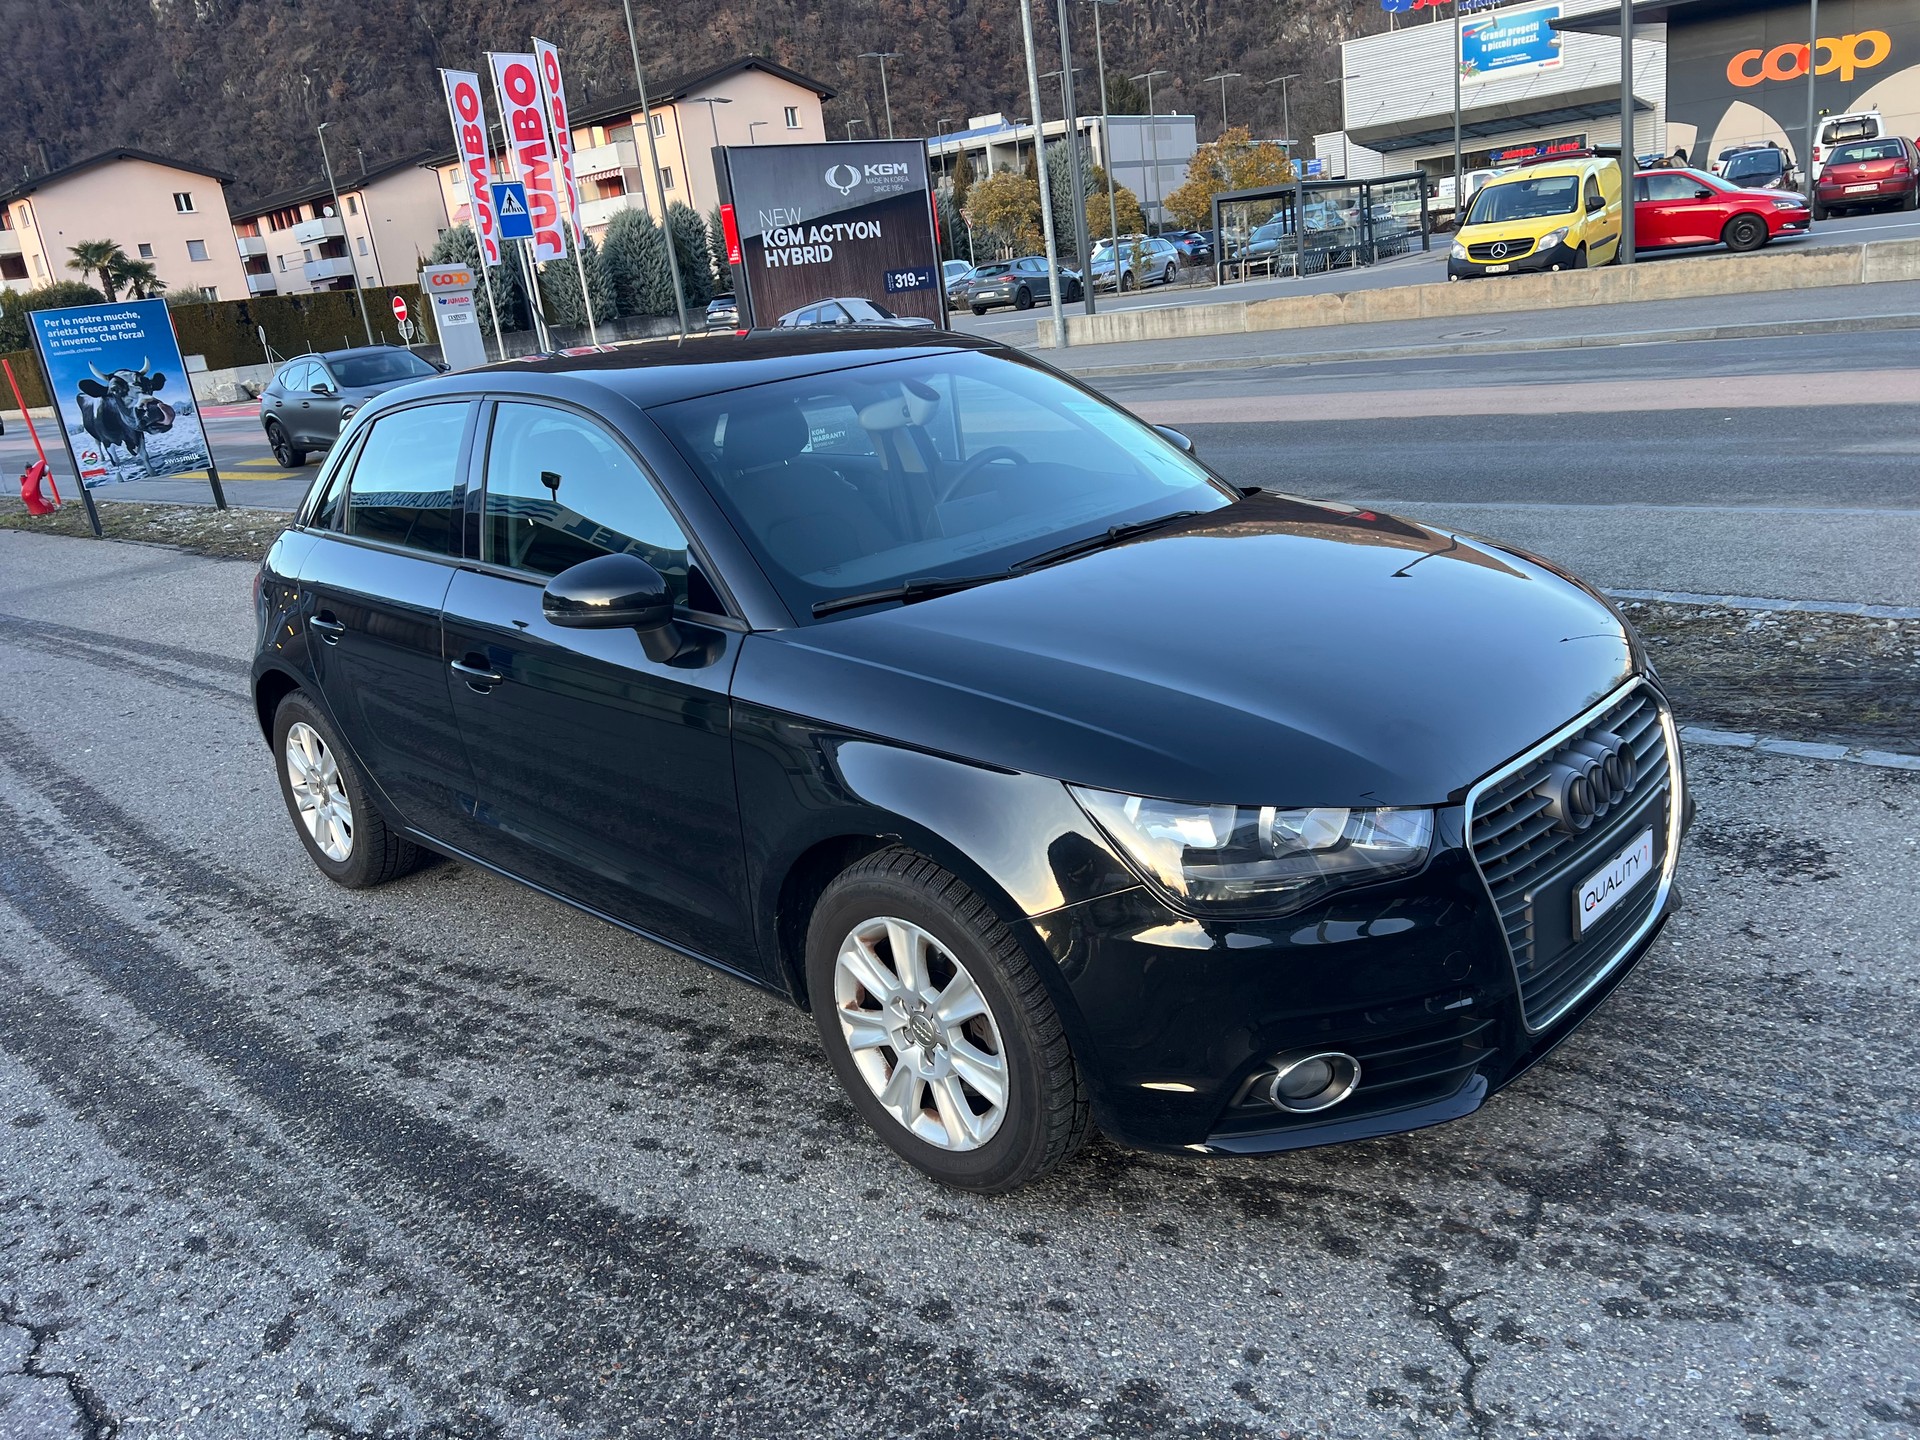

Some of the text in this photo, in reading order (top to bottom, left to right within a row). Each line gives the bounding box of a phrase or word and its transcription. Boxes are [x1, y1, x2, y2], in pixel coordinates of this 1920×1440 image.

[1480, 21, 1540, 41] Grandi progetti
[1488, 37, 1512, 51] piccoli
[1513, 32, 1540, 47] prezzi.
[1726, 30, 1892, 88] coop
[504, 63, 562, 254] JUMBO
[455, 82, 497, 262] JUMBO
[864, 163, 908, 176] KGM
[759, 207, 801, 228] NEW
[761, 220, 882, 248] KGM ACTYON
[764, 244, 833, 268] HYBRID
[431, 272, 471, 287] coop
[44, 311, 141, 328] Per le nostre mucche,
[47, 321, 137, 337] arietta fresca anche
[50, 330, 145, 348] in inverno. Che forza!
[811, 428, 826, 436] KGM
[811, 430, 846, 443] WARRANTY
[164, 453, 200, 465] swissmilk
